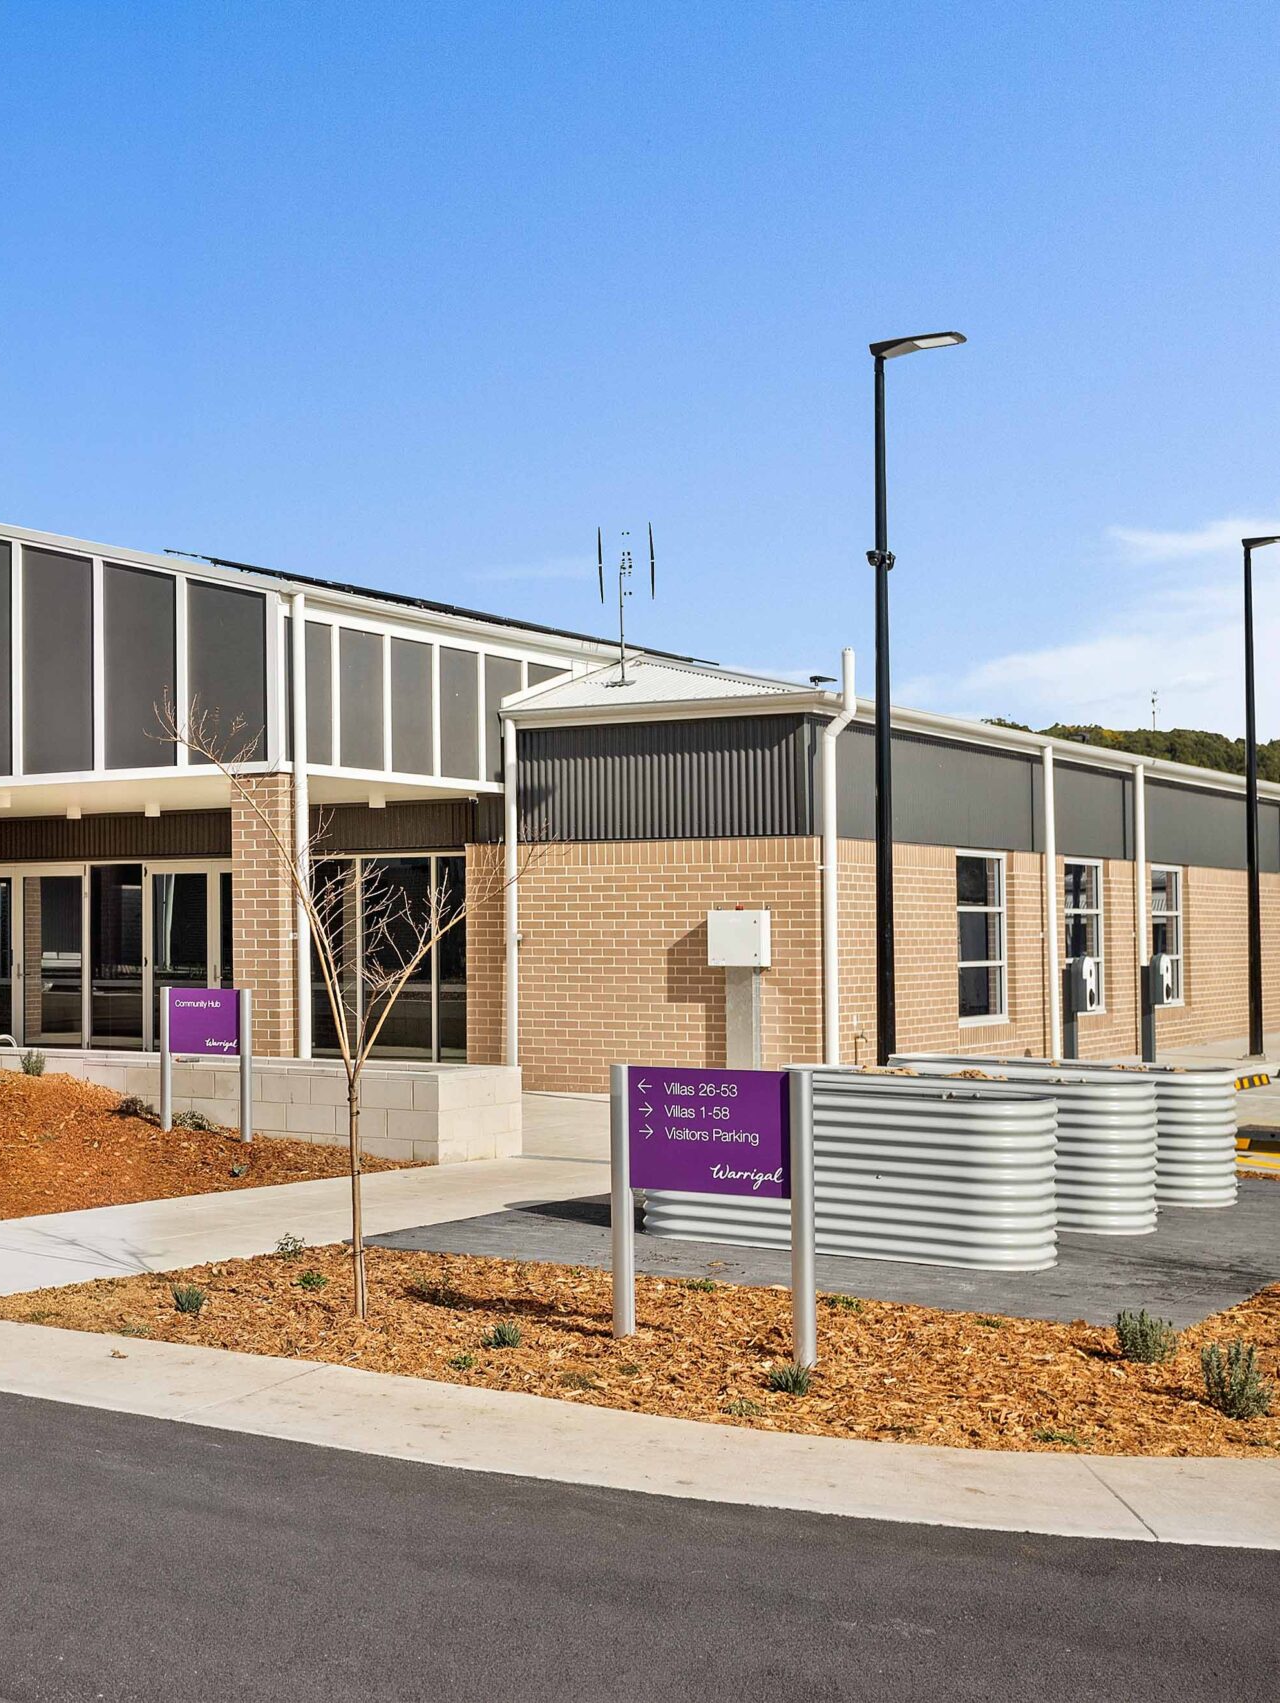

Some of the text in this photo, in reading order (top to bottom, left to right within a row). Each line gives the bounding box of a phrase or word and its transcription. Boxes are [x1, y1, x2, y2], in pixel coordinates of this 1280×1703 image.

[175, 1000, 221, 1009] Community Hub
[205, 1038, 238, 1051] Warrigal
[664, 1082, 738, 1098] Villas 26-53
[664, 1105, 730, 1120] Villas 1-58
[665, 1127, 760, 1147] Visitors Parking
[710, 1164, 784, 1191] Warrigal
